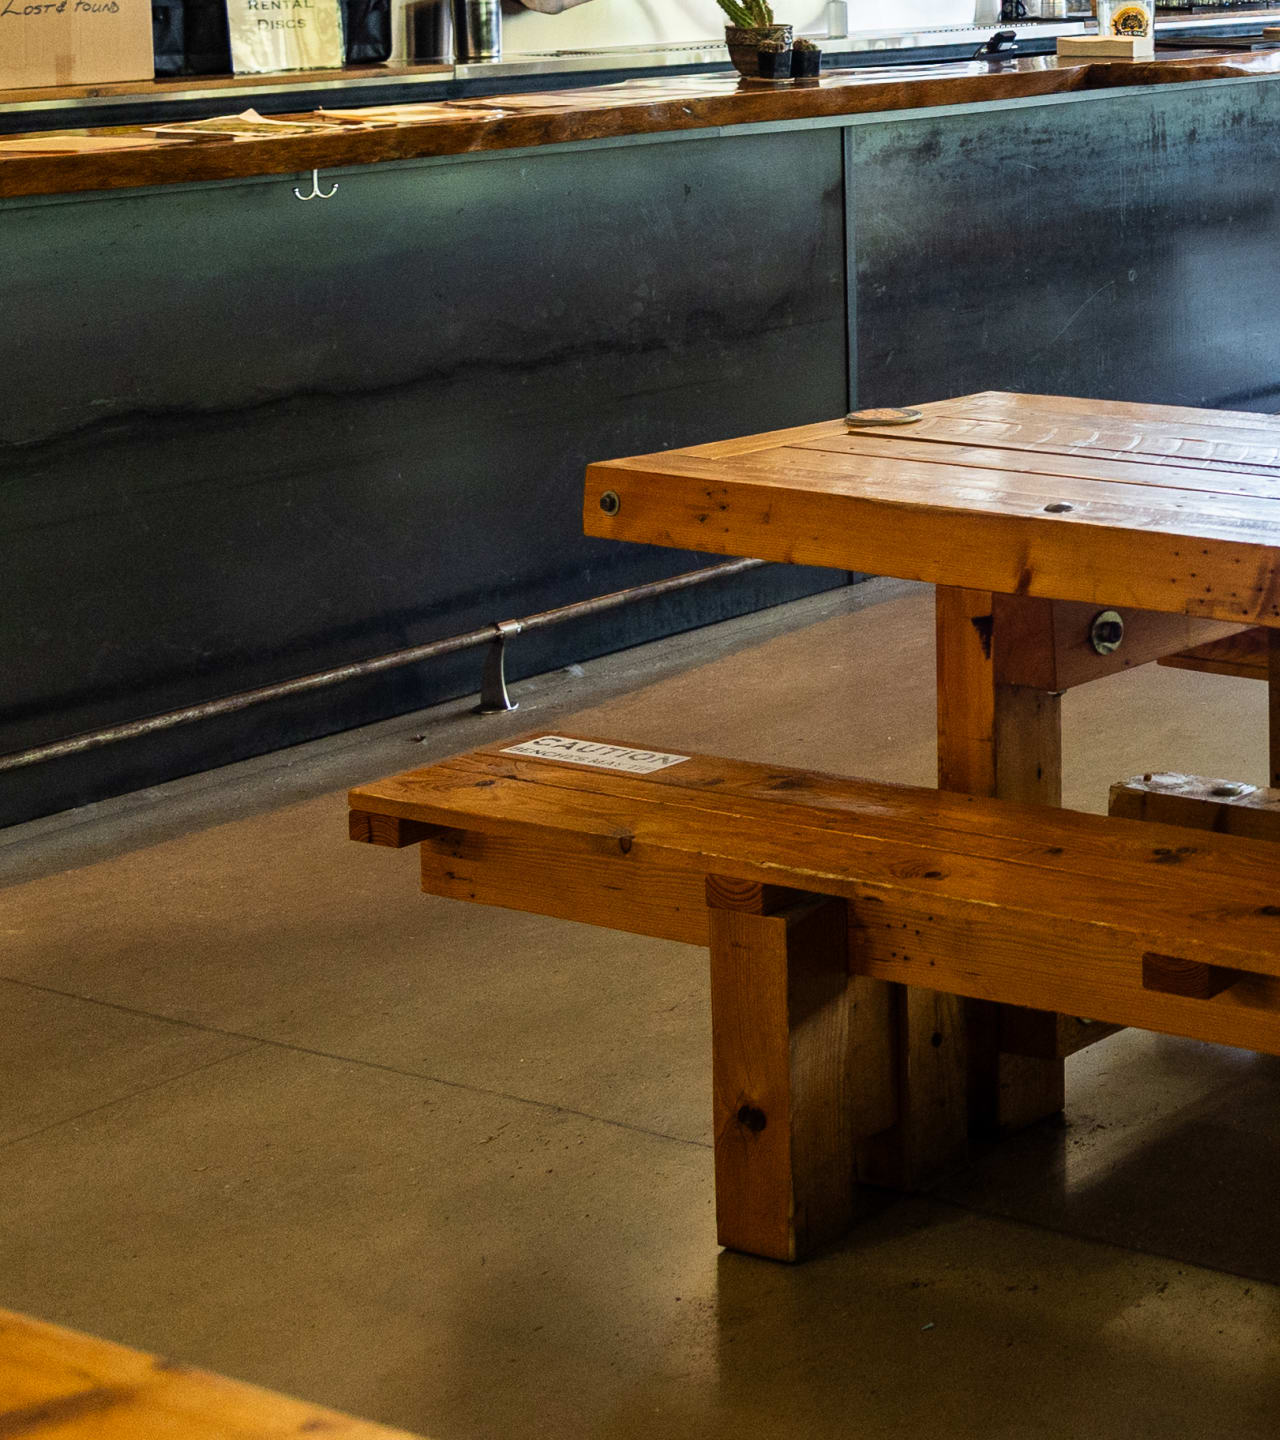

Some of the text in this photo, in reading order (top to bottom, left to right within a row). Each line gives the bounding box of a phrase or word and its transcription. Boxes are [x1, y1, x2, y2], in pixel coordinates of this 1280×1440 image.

[248, 0, 314, 10] RENTAL
[257, 18, 307, 31] DISCS
[532, 737, 682, 765] CAUTION
